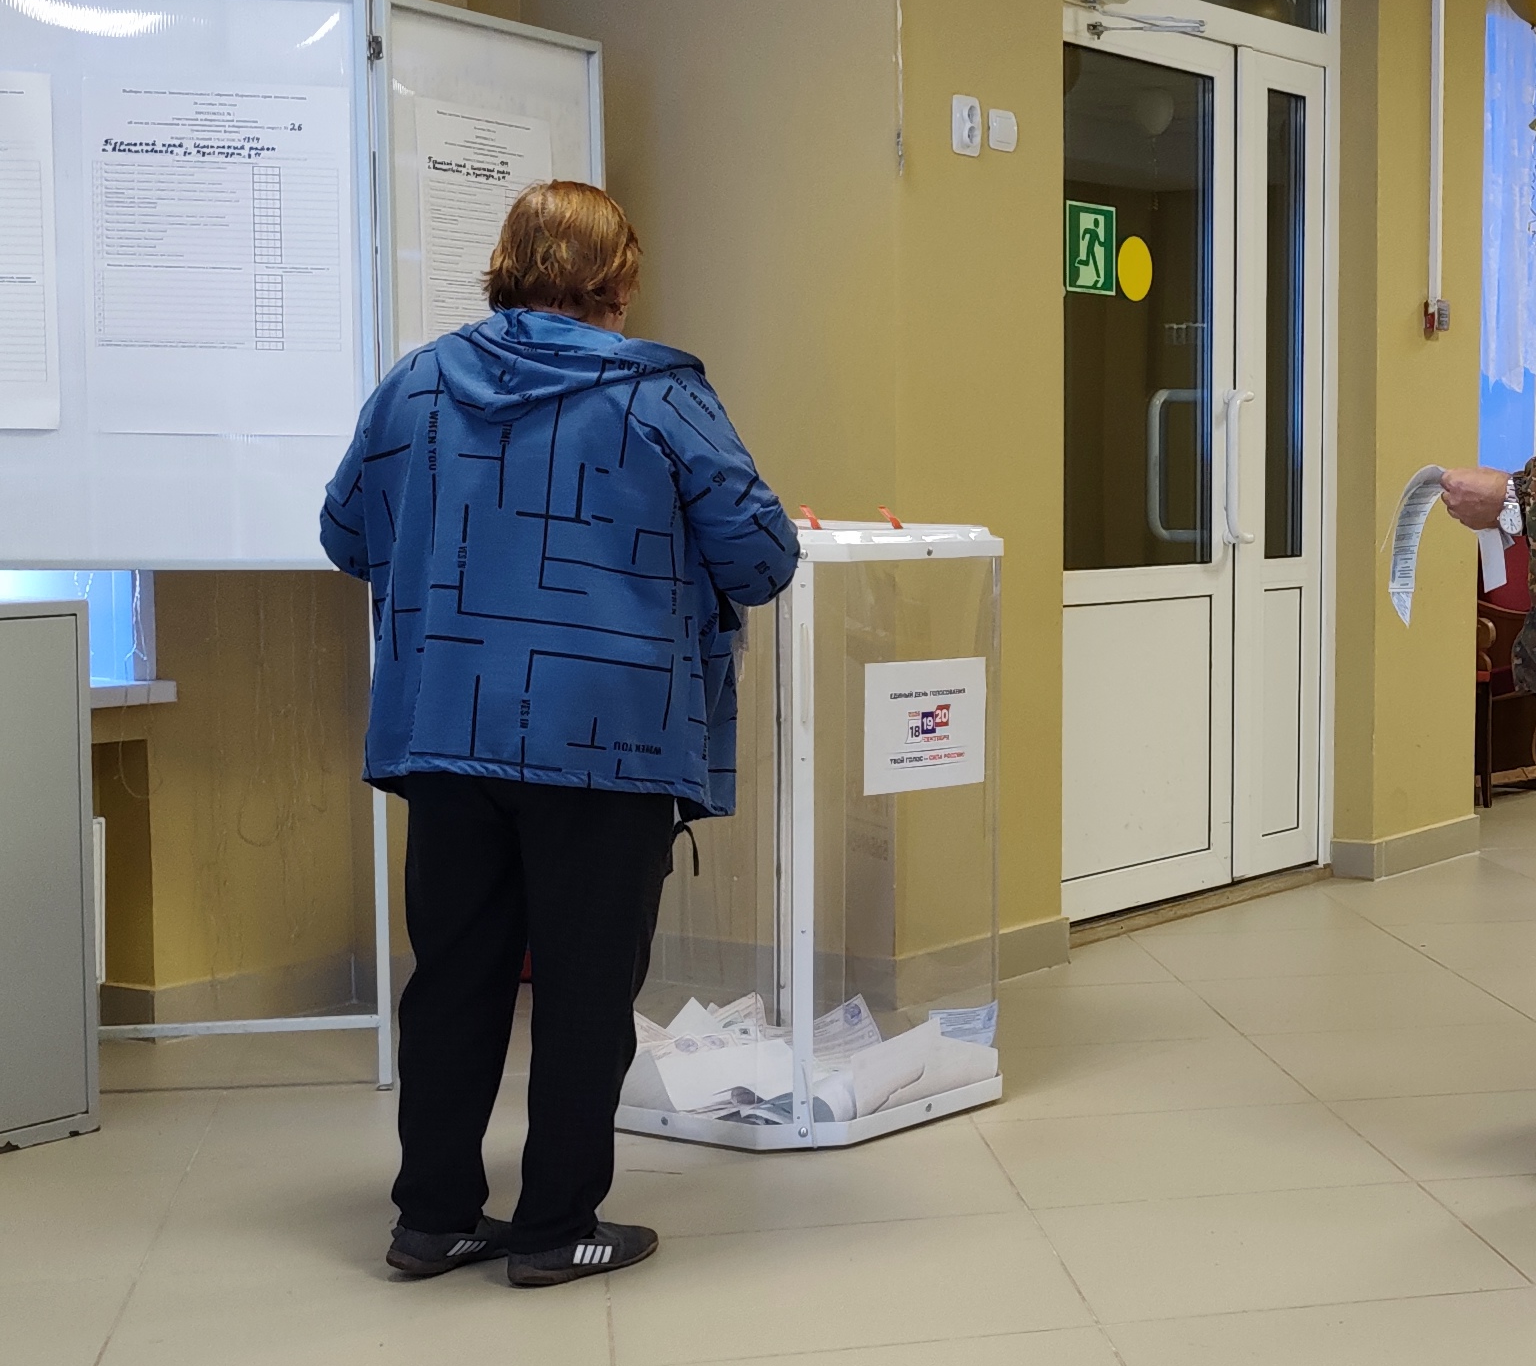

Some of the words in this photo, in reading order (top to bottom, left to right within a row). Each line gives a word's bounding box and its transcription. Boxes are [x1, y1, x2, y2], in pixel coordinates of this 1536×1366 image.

[427, 410, 439, 444] WHEN
[427, 447, 437, 471] YOU
[909, 725, 920, 738] 18
[923, 717, 933, 730] 19
[936, 709, 948, 722] 20
[613, 741, 633, 753] YOU
